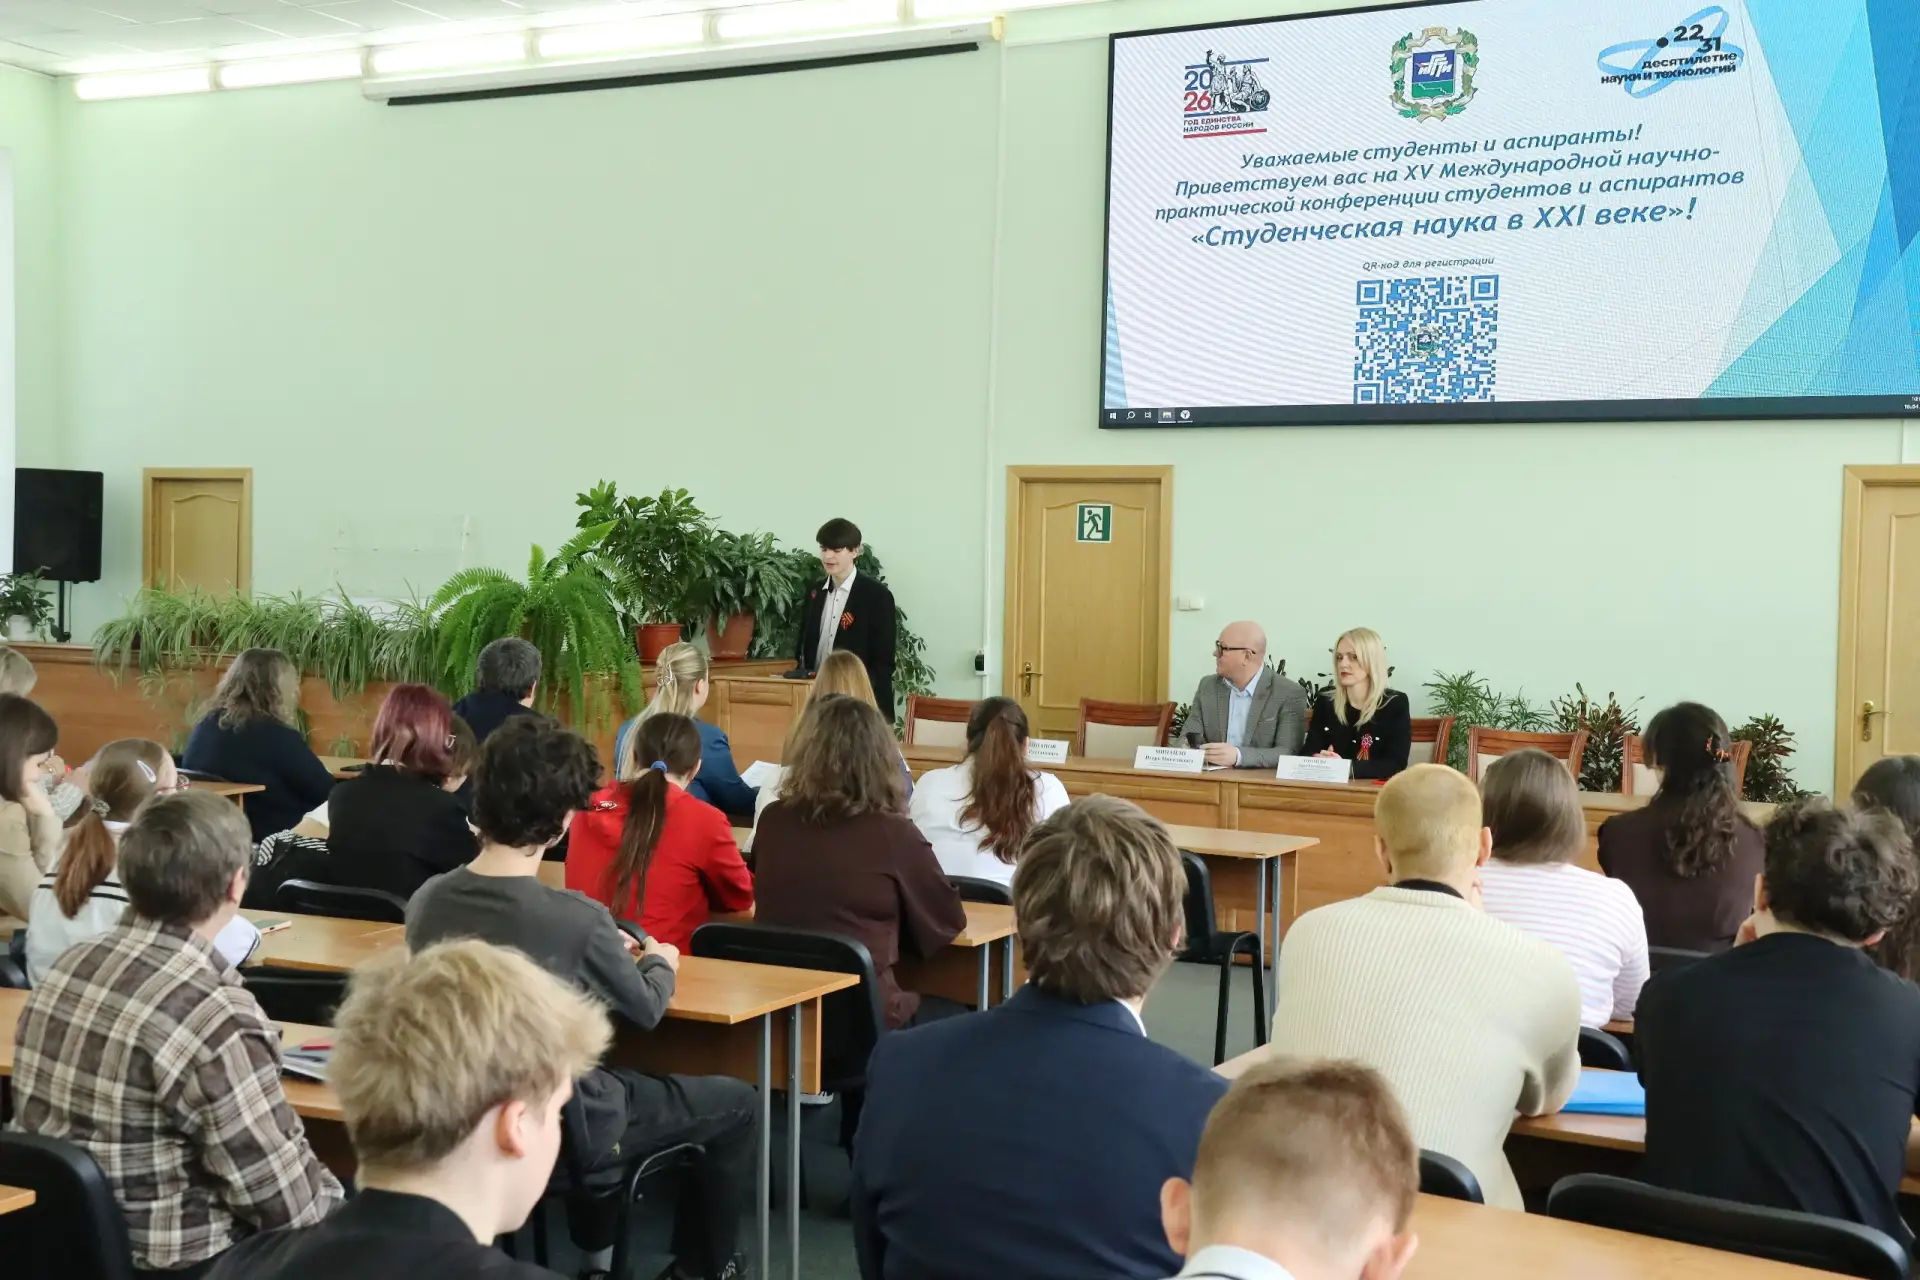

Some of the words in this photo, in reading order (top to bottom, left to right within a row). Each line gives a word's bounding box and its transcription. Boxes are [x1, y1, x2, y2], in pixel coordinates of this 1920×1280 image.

[1673, 24, 1704, 42] 22
[1697, 36, 1721, 53] 31
[1641, 52, 1737, 70] десятилетие
[1184, 69, 1213, 91] 20
[1601, 72, 1642, 85] науки
[1643, 71, 1652, 81] и
[1654, 62, 1736, 80] технологий
[1183, 90, 1212, 112] 26
[1183, 118, 1199, 126] ГОД
[1201, 115, 1242, 125] ЕДИНСТВА
[1183, 124, 1220, 133] НАРОДОВ
[1221, 121, 1254, 130] РОССИИ
[1240, 149, 1358, 169] Уважаемые
[1363, 140, 1477, 163] студенты
[1483, 139, 1496, 151] и
[1503, 123, 1643, 151] аспиранты!
[1175, 175, 1327, 198] Приветствуем
[1333, 170, 1367, 186] вас
[1373, 169, 1398, 183] на
[1404, 164, 1434, 181] XV
[1439, 150, 1622, 179] Международной
[1627, 147, 1720, 168] научно-
[1155, 197, 1295, 222] практической
[1300, 189, 1438, 213] конференции
[1444, 179, 1572, 204] студентов
[1578, 181, 1592, 194] и
[1599, 170, 1745, 193] аспирантов
[1191, 219, 1403, 250] «Студенческая
[1413, 213, 1497, 239] наука
[1507, 213, 1524, 230] в
[1533, 204, 1586, 230] XXI
[1594, 197, 1697, 226] веке»!
[1362, 260, 1399, 272] QR-код
[1402, 260, 1421, 269] для
[1424, 257, 1495, 268] регистрации
